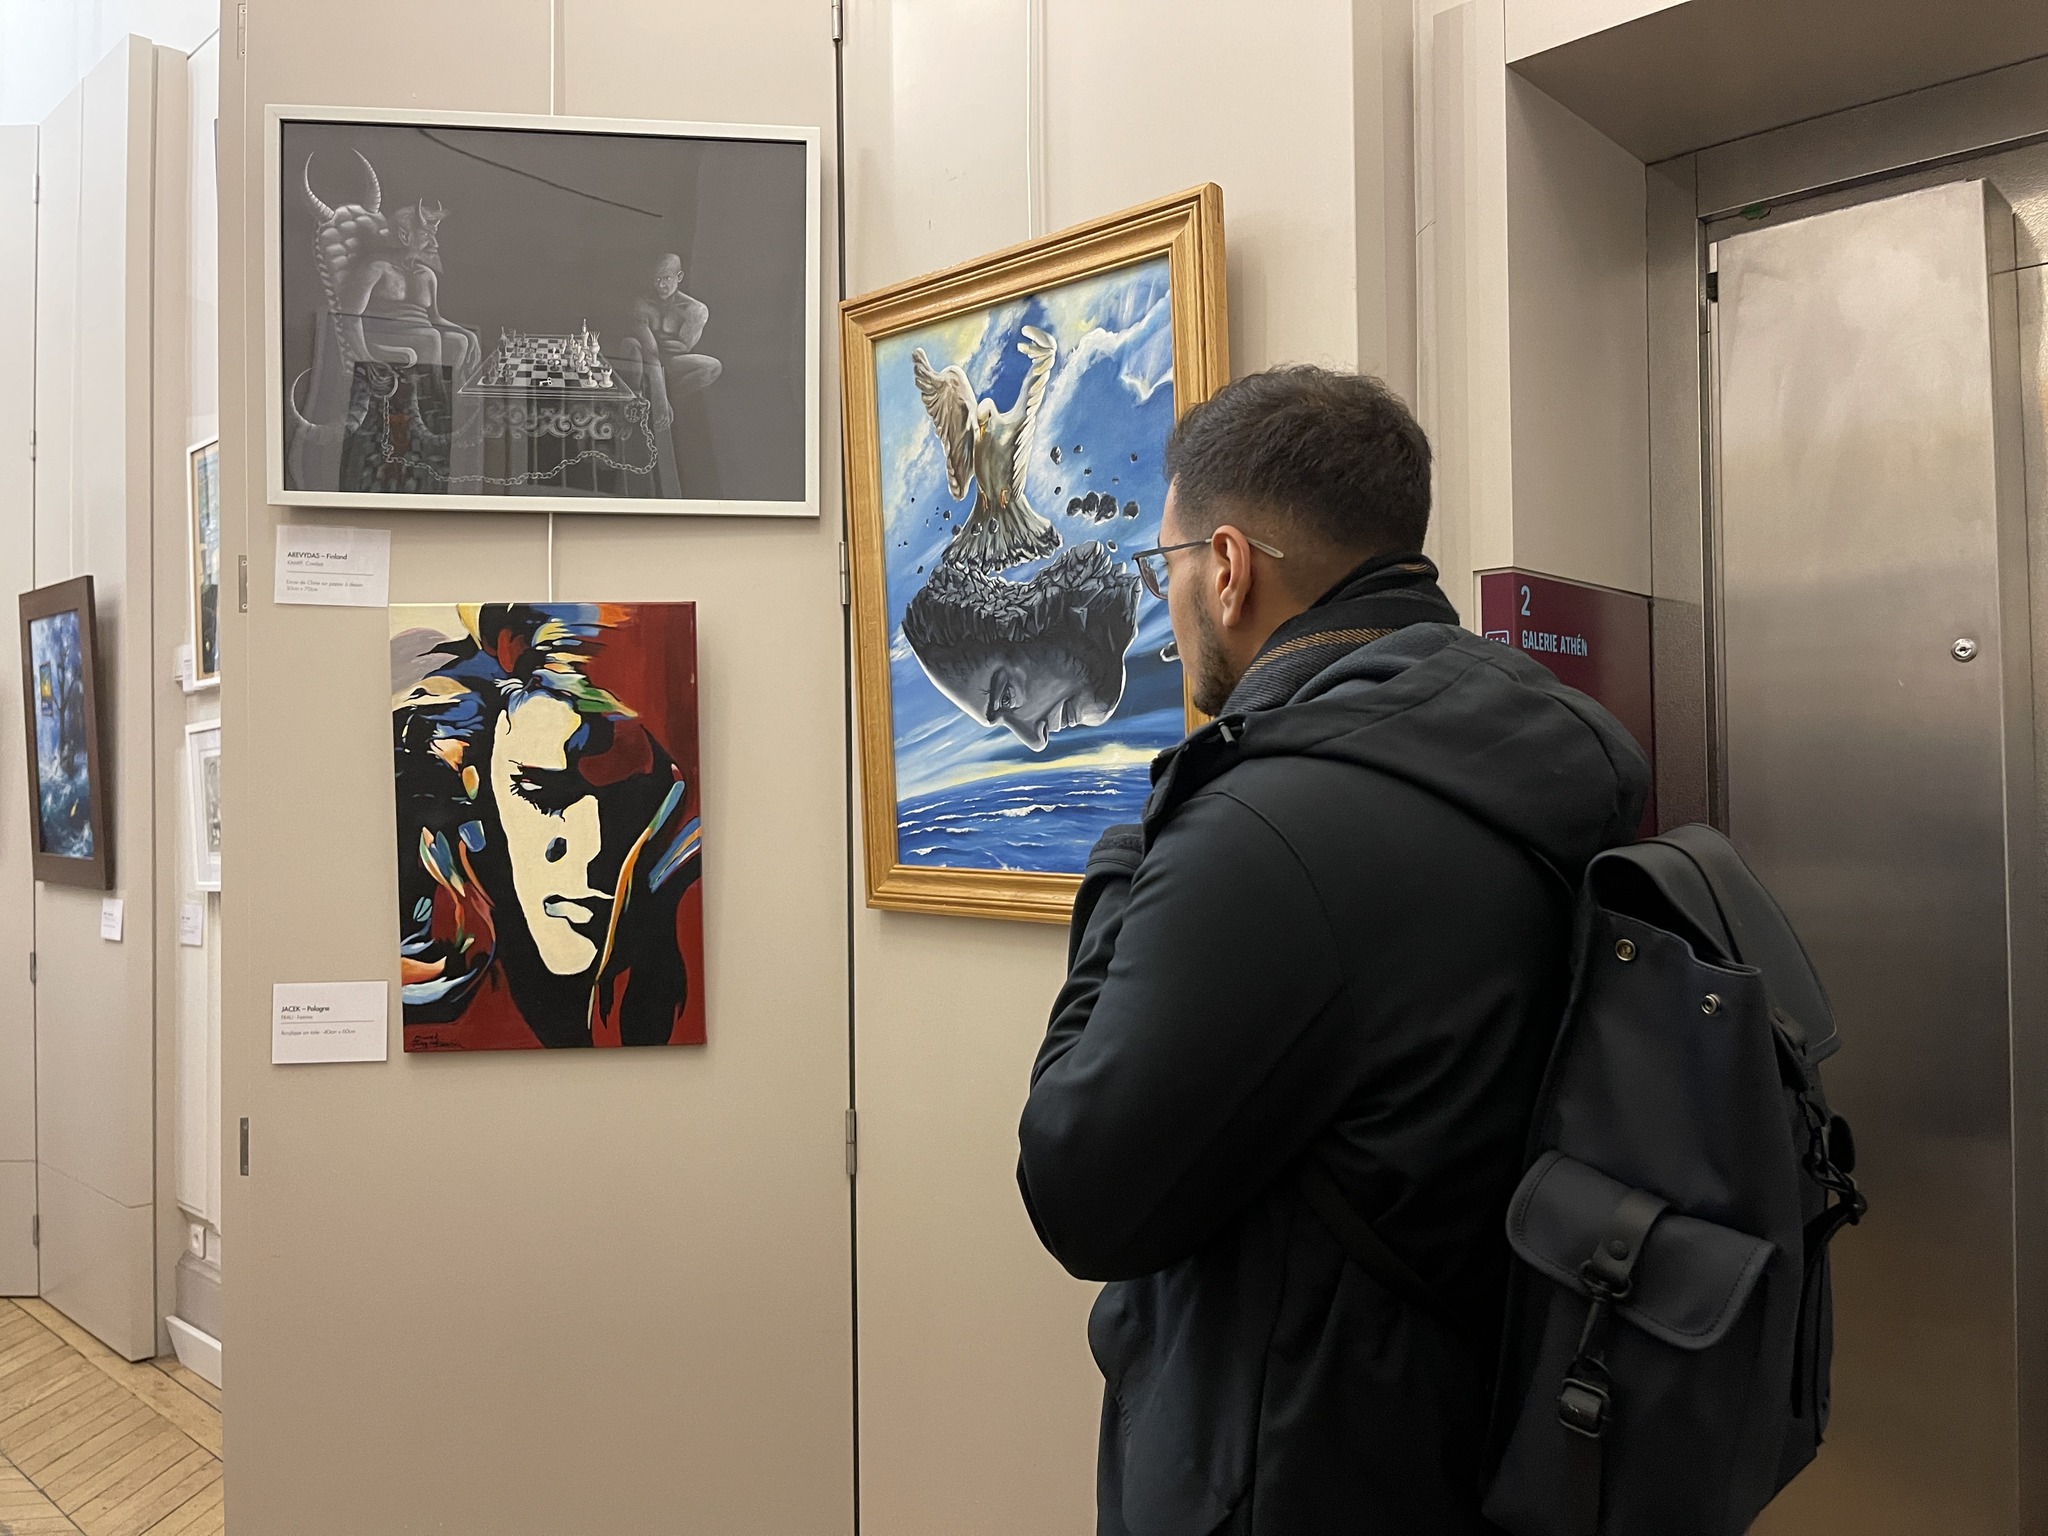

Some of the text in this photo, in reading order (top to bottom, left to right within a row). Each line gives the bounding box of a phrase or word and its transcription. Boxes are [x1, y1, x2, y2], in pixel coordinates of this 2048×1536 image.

[1520, 585, 1531, 616] 2
[1522, 629, 1558, 653] GALERIE
[281, 1005, 300, 1013] JACEK
[307, 1005, 330, 1013] Pologne
